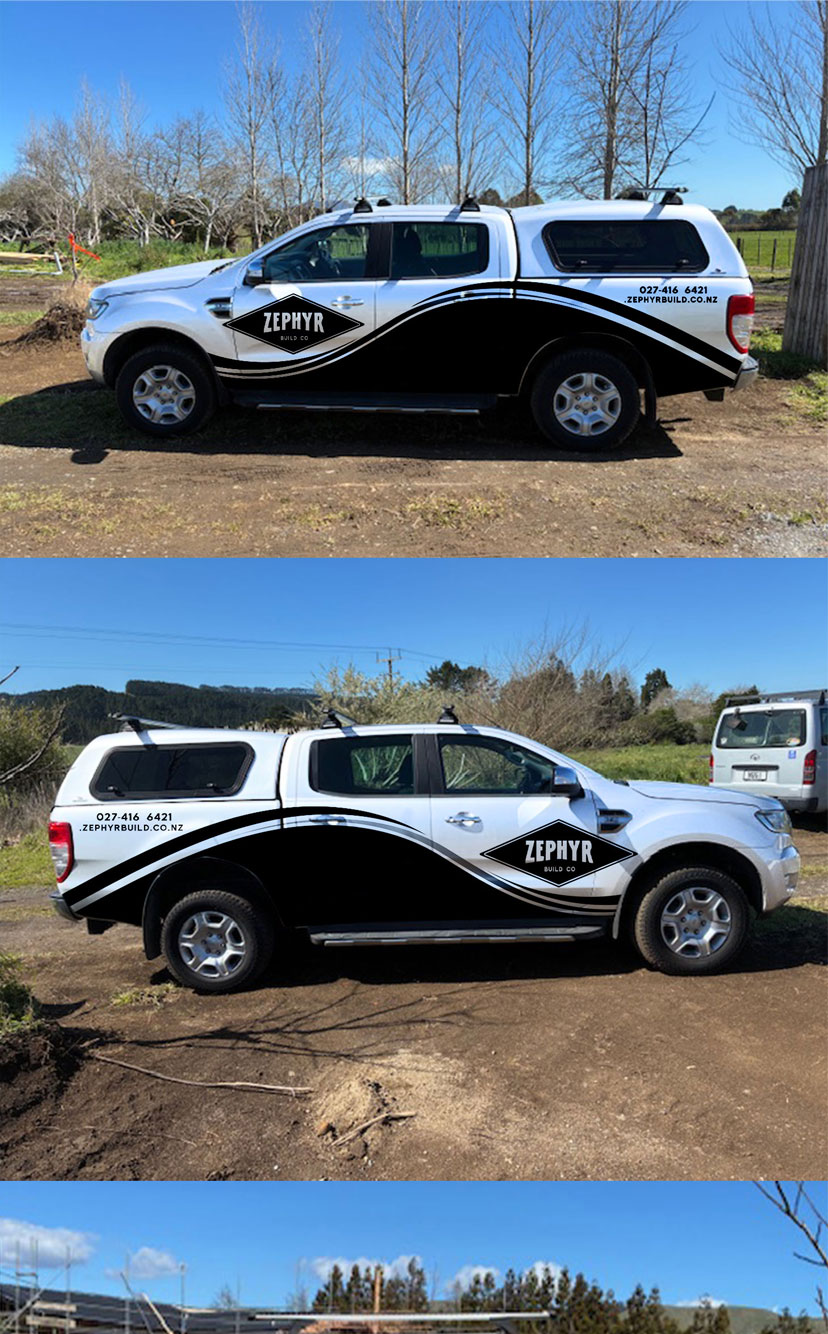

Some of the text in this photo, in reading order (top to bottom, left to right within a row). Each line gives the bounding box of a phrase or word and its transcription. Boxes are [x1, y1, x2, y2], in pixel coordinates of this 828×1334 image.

[639, 286, 708, 294] 027-416 6421
[263, 312, 325, 333] ZEPHYR
[96, 813, 172, 821] 027-416 6421
[525, 840, 594, 864] ZEPHYR
